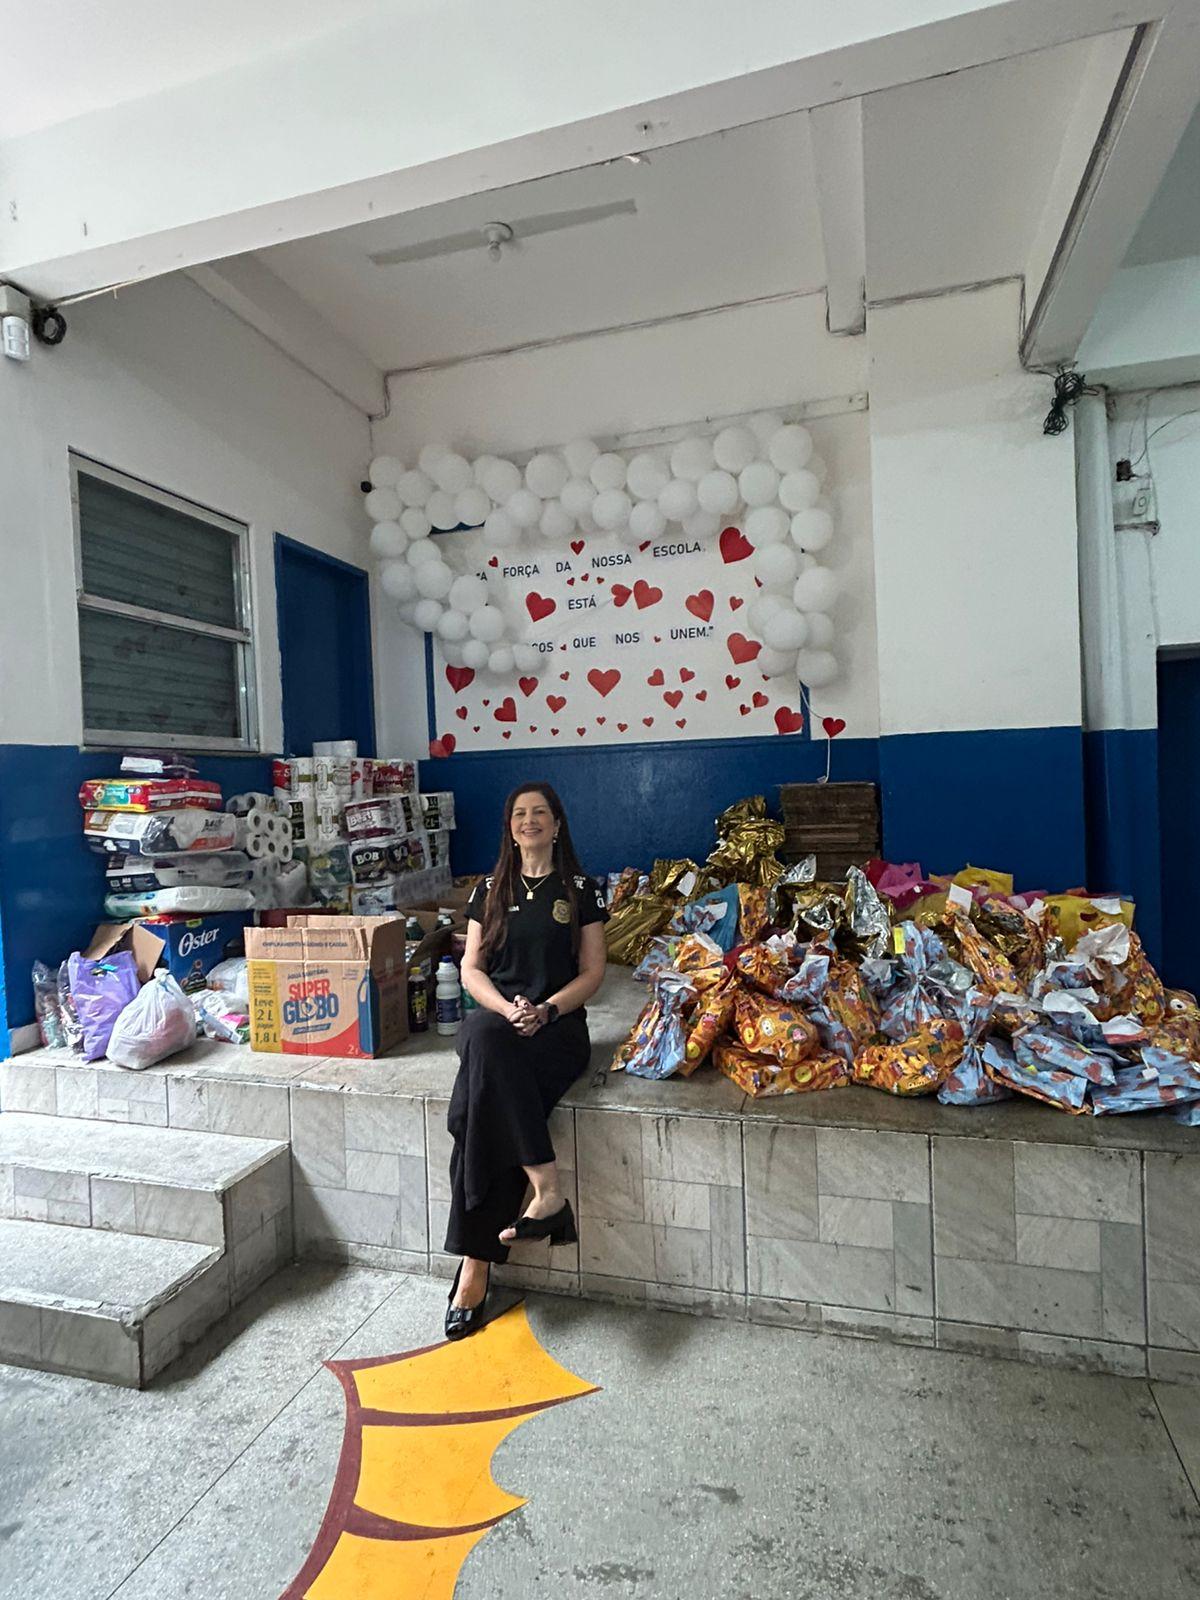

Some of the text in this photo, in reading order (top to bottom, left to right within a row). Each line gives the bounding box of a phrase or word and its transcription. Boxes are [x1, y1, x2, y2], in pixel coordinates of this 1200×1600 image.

[503, 564, 540, 578] FORÇA
[556, 561, 572, 573] DA
[591, 554, 632, 568] NOSSA
[568, 594, 597, 610] ESTÁ
[531, 641, 554, 653] OS
[573, 636, 597, 649] QUE
[615, 632, 640, 645] NOS
[355, 851, 380, 865] BOB
[178, 928, 220, 957] Oster
[288, 978, 330, 1001] SUPER
[254, 998, 274, 1007] Leve
[283, 993, 339, 1024] GLOBO
[256, 1008, 265, 1021] 2
[255, 1031, 270, 1044] 1,8
